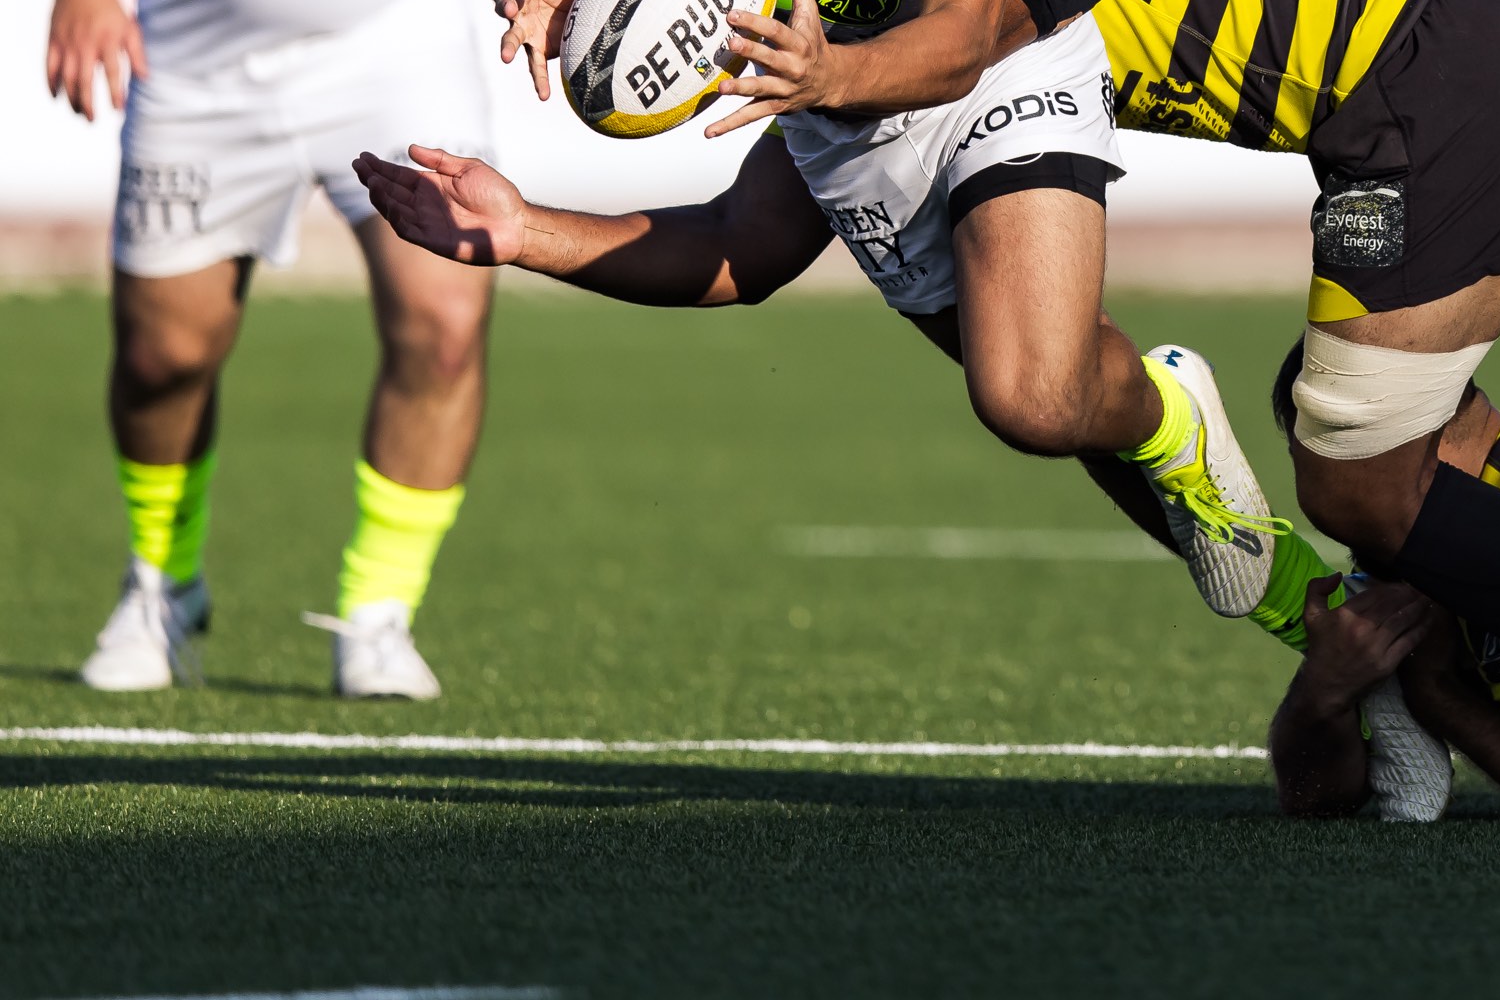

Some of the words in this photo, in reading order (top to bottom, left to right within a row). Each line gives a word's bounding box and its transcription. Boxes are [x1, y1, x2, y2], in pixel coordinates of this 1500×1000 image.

[626, 41, 681, 110] BE
[1326, 208, 1385, 230] Everest
[1343, 234, 1384, 251] Energy
